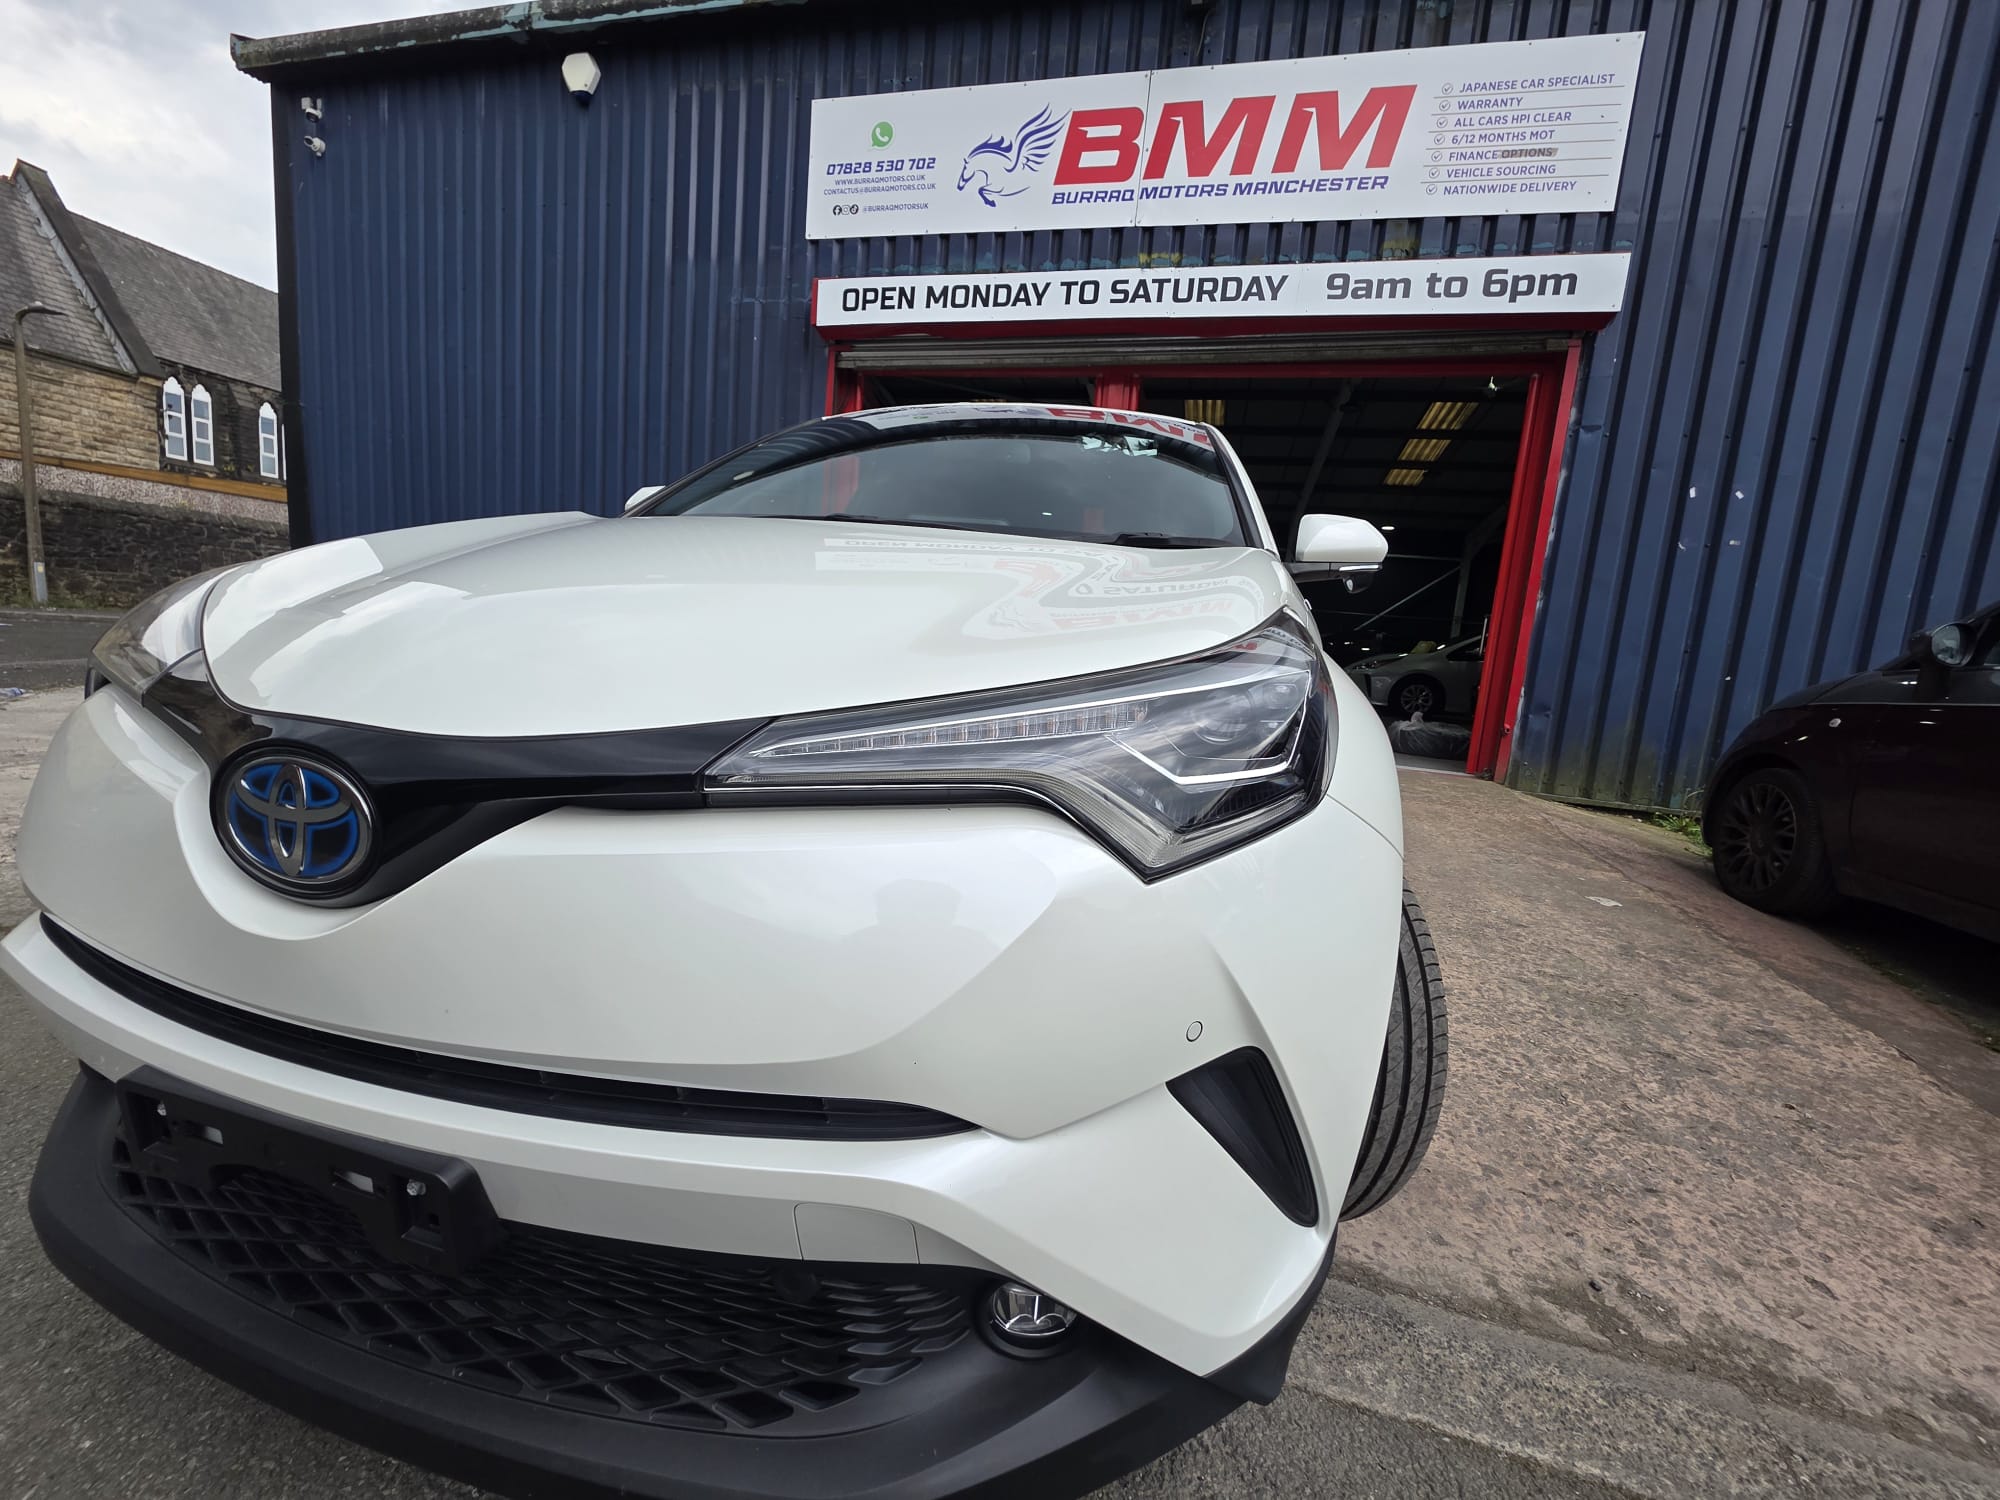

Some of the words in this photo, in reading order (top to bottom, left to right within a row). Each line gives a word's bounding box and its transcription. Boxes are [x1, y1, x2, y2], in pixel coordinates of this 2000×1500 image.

[1459, 80, 1518, 94] JAPANESE
[1520, 77, 1545, 90] CAR
[1547, 73, 1616, 88] SPECIALIST
[1457, 97, 1524, 111] WARRANTY
[1454, 116, 1475, 127] ALL
[1478, 114, 1508, 126] CARS
[1511, 114, 1531, 125] HPI
[1534, 111, 1572, 123] CLEAR
[1053, 84, 1418, 186] BMM
[1451, 134, 1476, 145] 6/12
[1478, 132, 1527, 145] MONTHS
[1529, 130, 1556, 141] MOT
[1449, 150, 1499, 162] FINANCE
[1501, 147, 1553, 160] OPTIONS
[826, 161, 872, 175] 07828
[875, 159, 904, 172] 530
[908, 157, 937, 170] 702
[1446, 167, 1493, 178] VEHICLE
[1496, 164, 1557, 177] SOURCING
[1051, 189, 1135, 205] BURRAQ
[1138, 183, 1229, 200] MOTORS
[1232, 175, 1389, 197] MANCHESTER
[1443, 183, 1518, 196] NATIONWIDE
[1519, 180, 1577, 193] DELIVERY
[842, 286, 915, 312] OPEN
[925, 282, 1052, 309] MONDAY
[1060, 279, 1101, 306] TO
[1109, 274, 1289, 304] SATURDAY
[1326, 272, 1412, 300] 9am
[1426, 272, 1469, 298] to
[1482, 268, 1579, 303] 6pm
